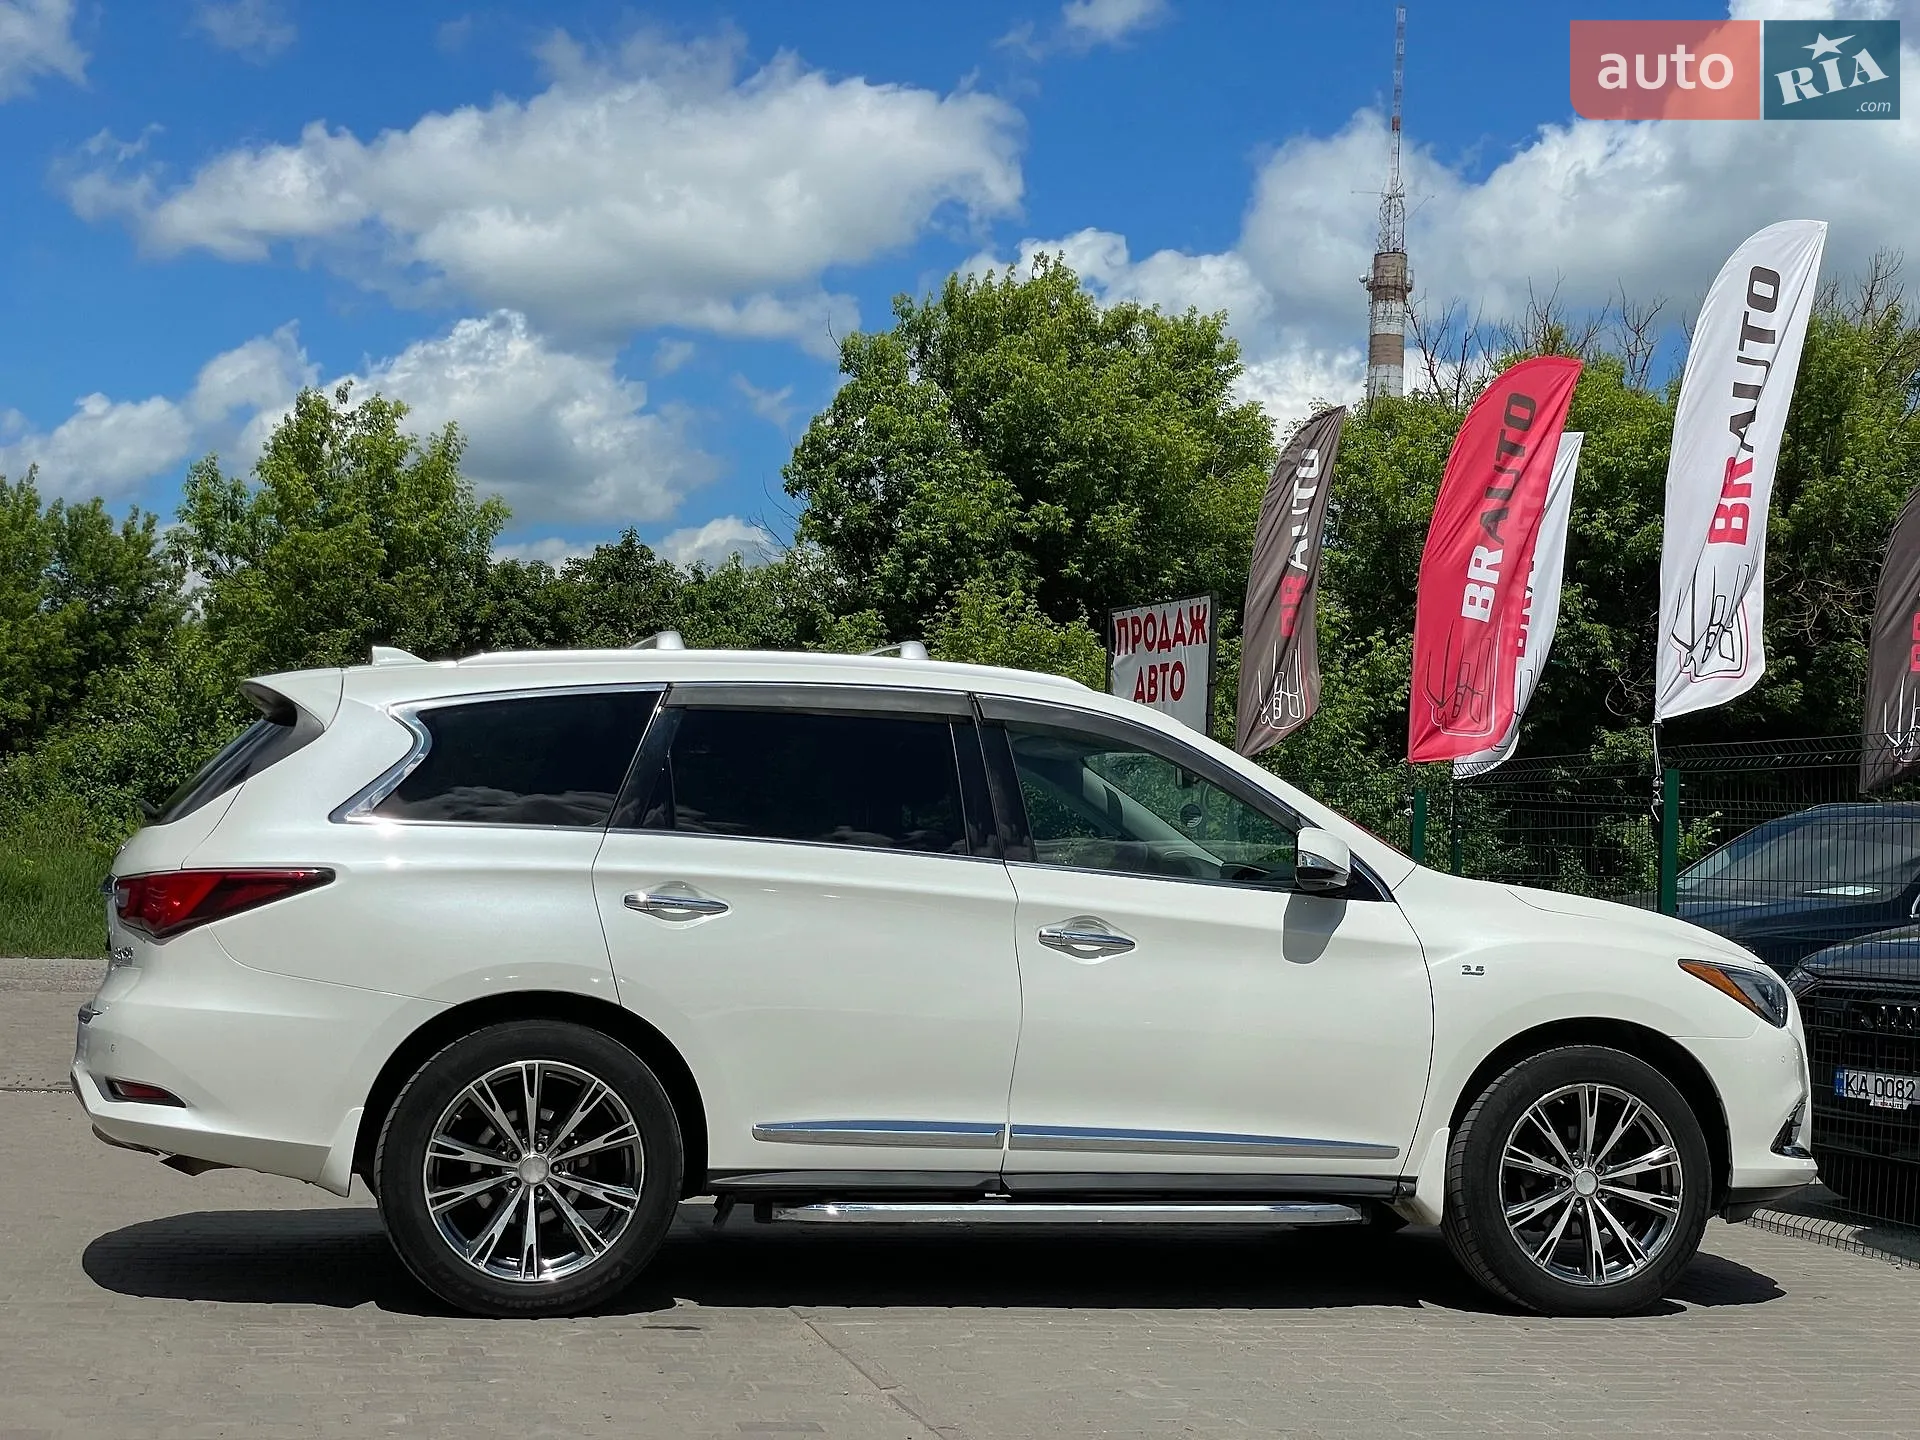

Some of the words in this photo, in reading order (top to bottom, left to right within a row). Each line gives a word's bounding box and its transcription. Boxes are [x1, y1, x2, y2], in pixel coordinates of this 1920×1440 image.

[1708, 265, 1781, 546] BRAUTO
[1461, 392, 1537, 623] BRAUTO
[1116, 603, 1208, 656] ПРОДАЖ
[1133, 660, 1186, 704] АВТО
